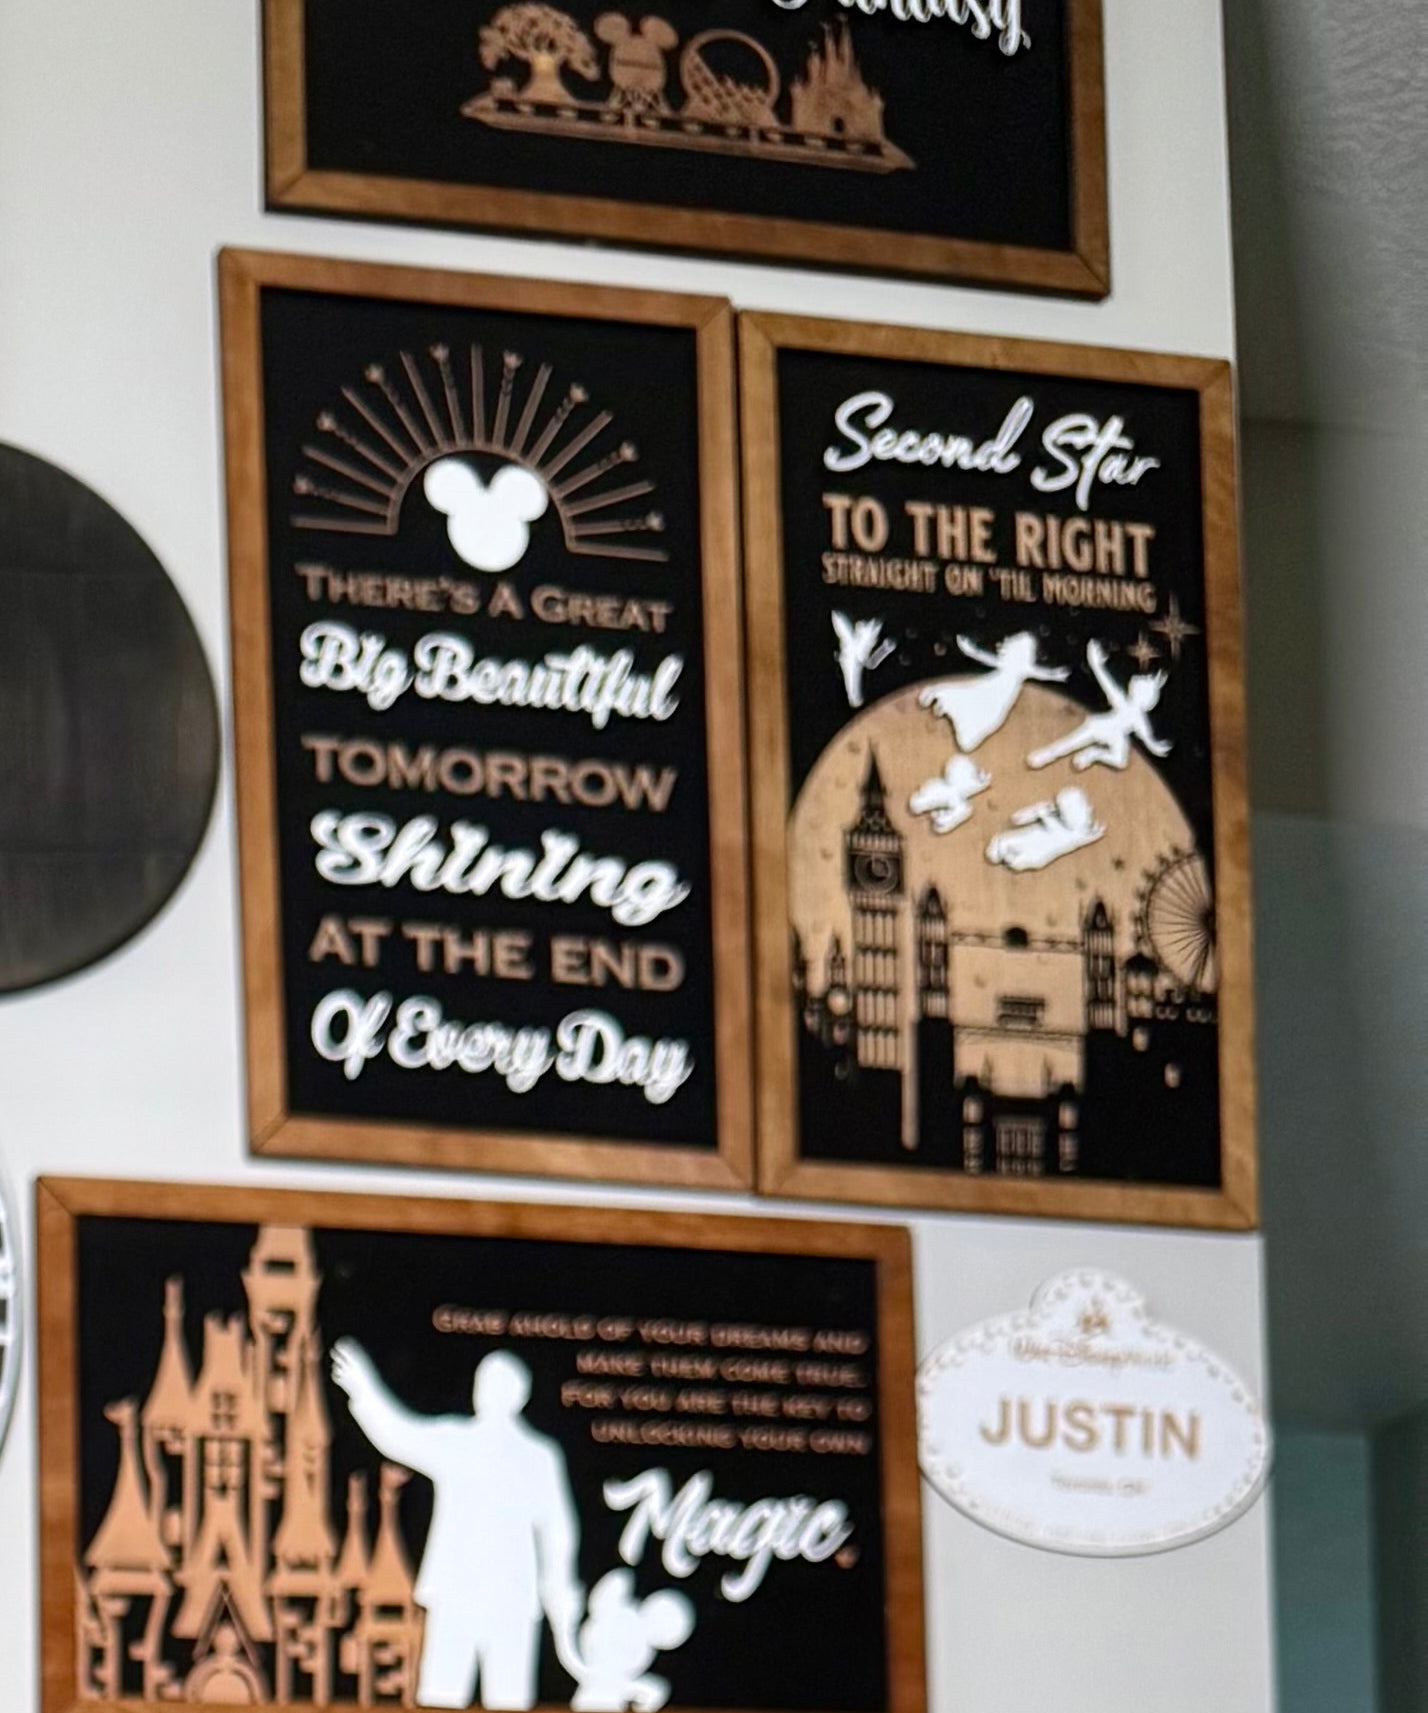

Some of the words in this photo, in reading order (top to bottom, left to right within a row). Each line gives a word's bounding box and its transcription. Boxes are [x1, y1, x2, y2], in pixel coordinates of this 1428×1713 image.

[823, 390, 1034, 474] Second
[1030, 413, 1160, 512] Star
[821, 493, 890, 552] TO
[903, 500, 998, 564] THE
[1014, 511, 1156, 579] RIGHT
[294, 562, 480, 616] THERE'S
[488, 580, 524, 621] A
[530, 584, 674, 634] GREAT
[821, 552, 937, 594] STRAIGHT
[944, 563, 984, 598] ON
[1042, 574, 1157, 614] MORNING
[299, 620, 415, 712] Big
[412, 630, 684, 730] Beautiful
[301, 735, 679, 812] TOMORROW
[309, 808, 692, 927] Shining
[308, 912, 392, 969] AT
[400, 919, 536, 981] THE
[549, 934, 686, 993] END
[310, 987, 393, 1082] Of
[387, 994, 556, 1094] Every
[554, 1008, 696, 1105] Day
[979, 1395, 1201, 1462] JUSTIN
